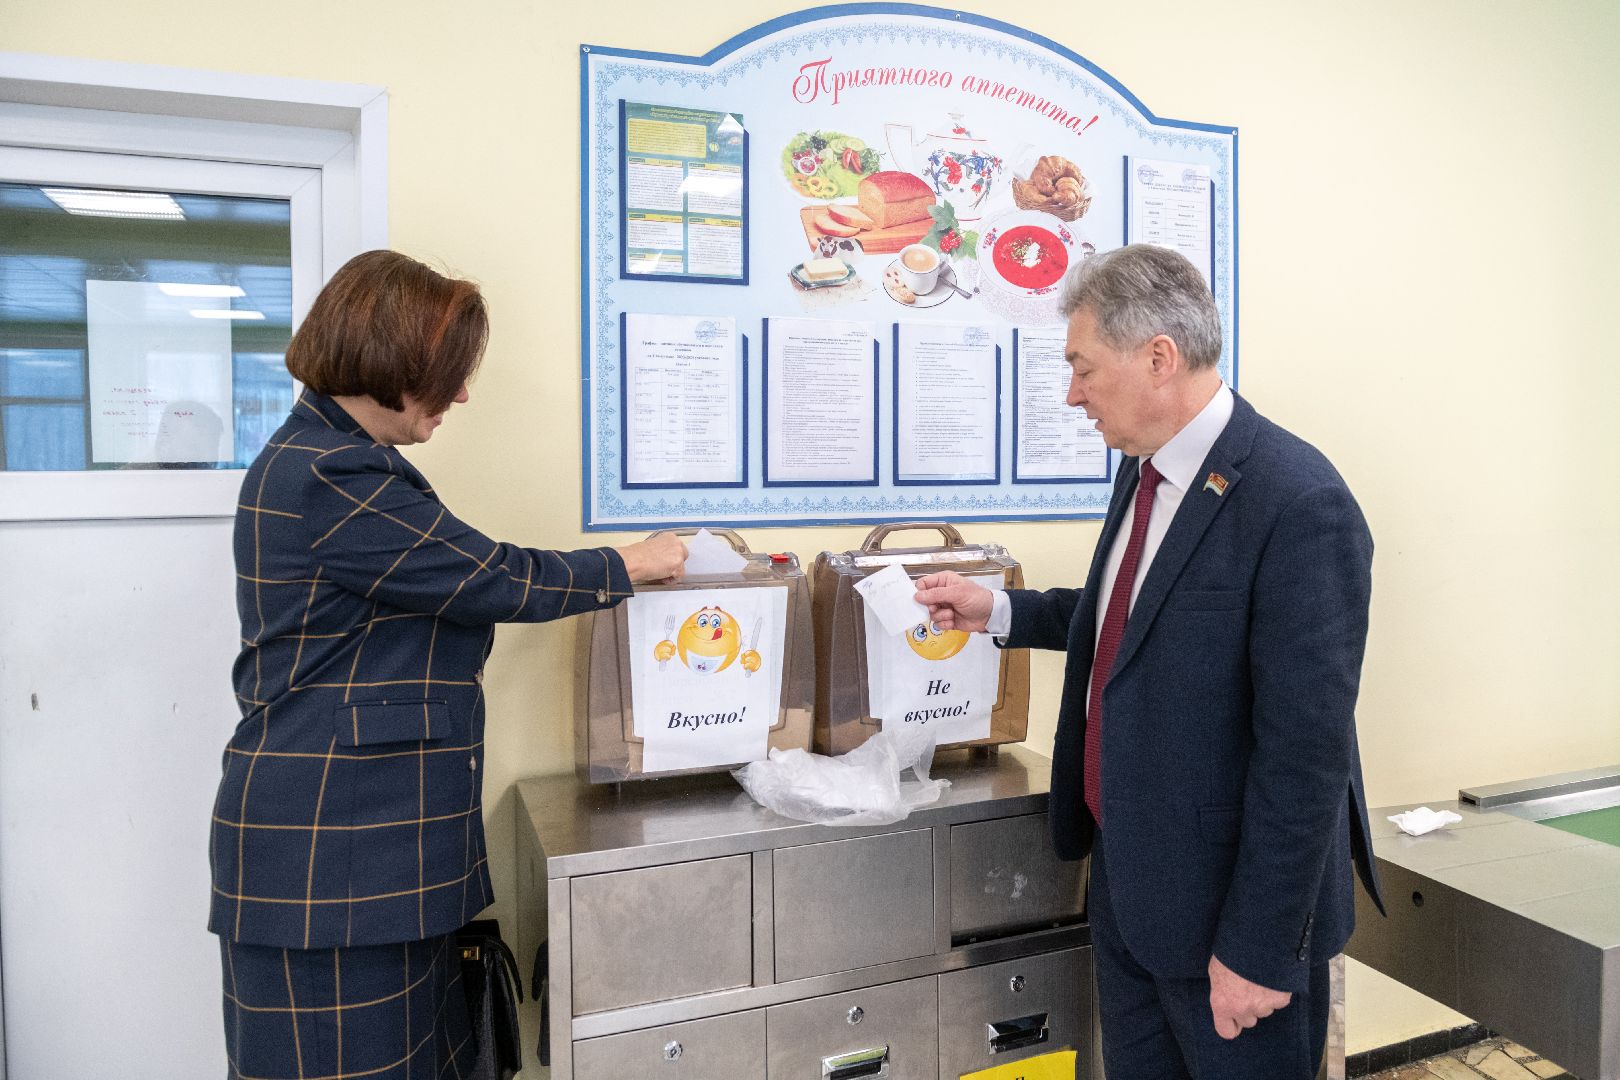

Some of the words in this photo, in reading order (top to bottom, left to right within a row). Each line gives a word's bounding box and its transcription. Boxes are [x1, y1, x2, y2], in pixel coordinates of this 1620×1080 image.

[792, 56, 953, 106] Приятного
[961, 74, 1099, 137] аппетита!
[925, 679, 951, 697] Не
[667, 706, 747, 731] Вкусно!
[904, 700, 970, 725] вкусно!
